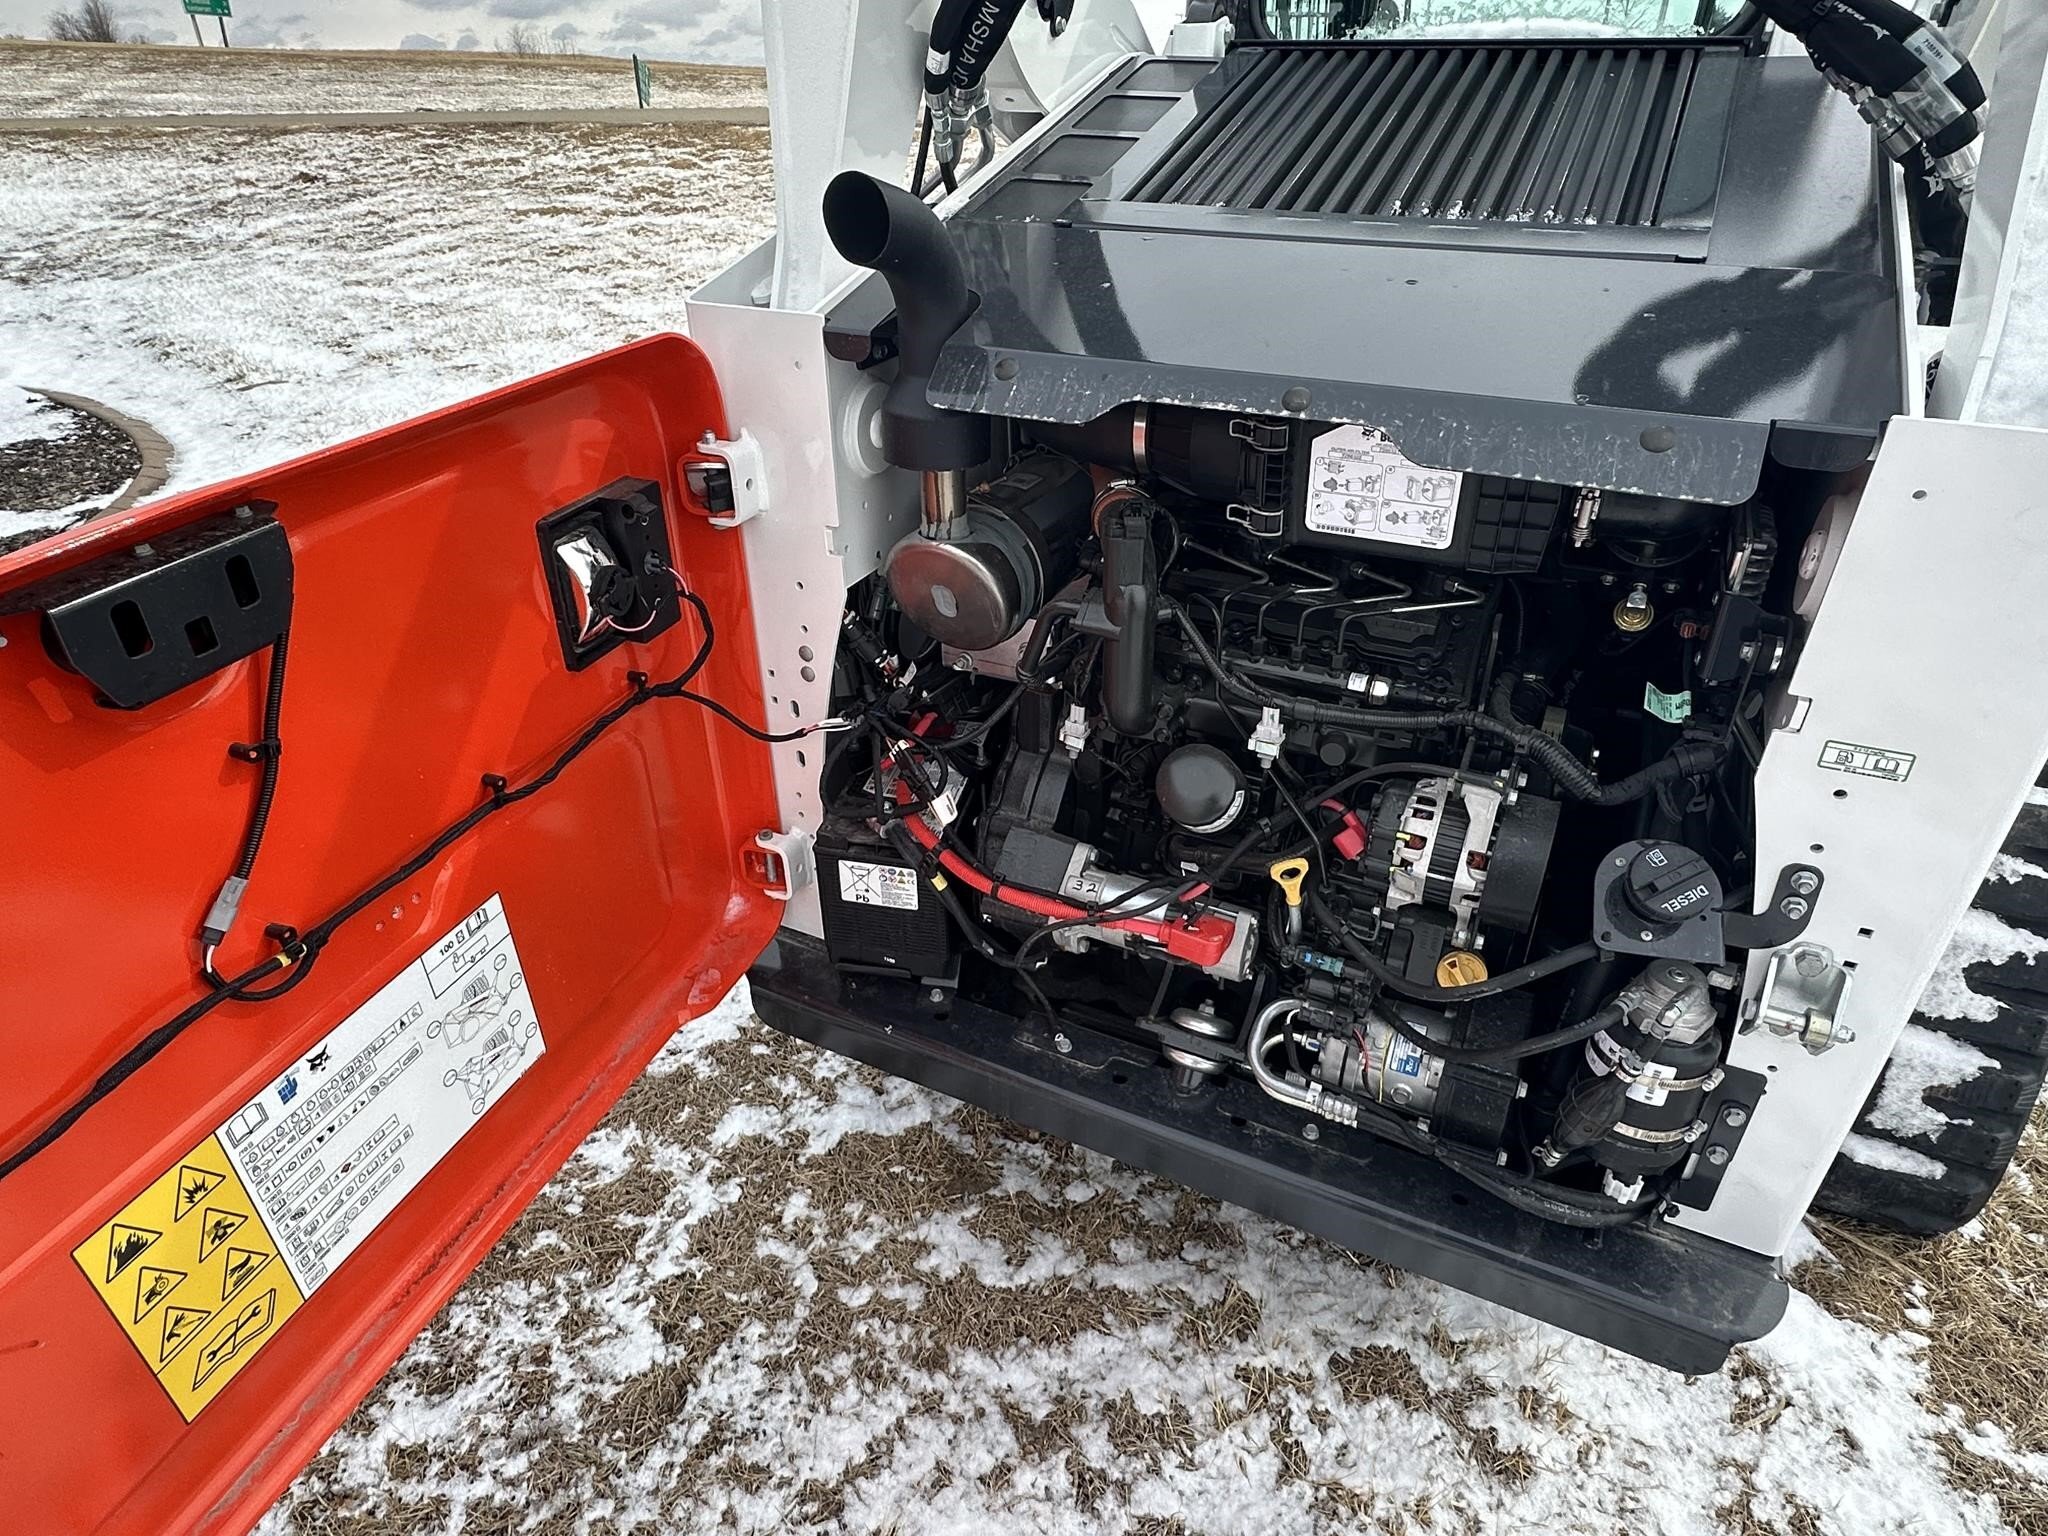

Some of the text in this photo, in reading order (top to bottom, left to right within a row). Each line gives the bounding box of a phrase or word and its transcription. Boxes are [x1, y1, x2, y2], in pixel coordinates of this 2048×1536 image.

[959, 1, 1000, 64] MSHA
[855, 893, 870, 903] Pb
[1660, 884, 1710, 913] DIESEL
[438, 940, 455, 957] 100
